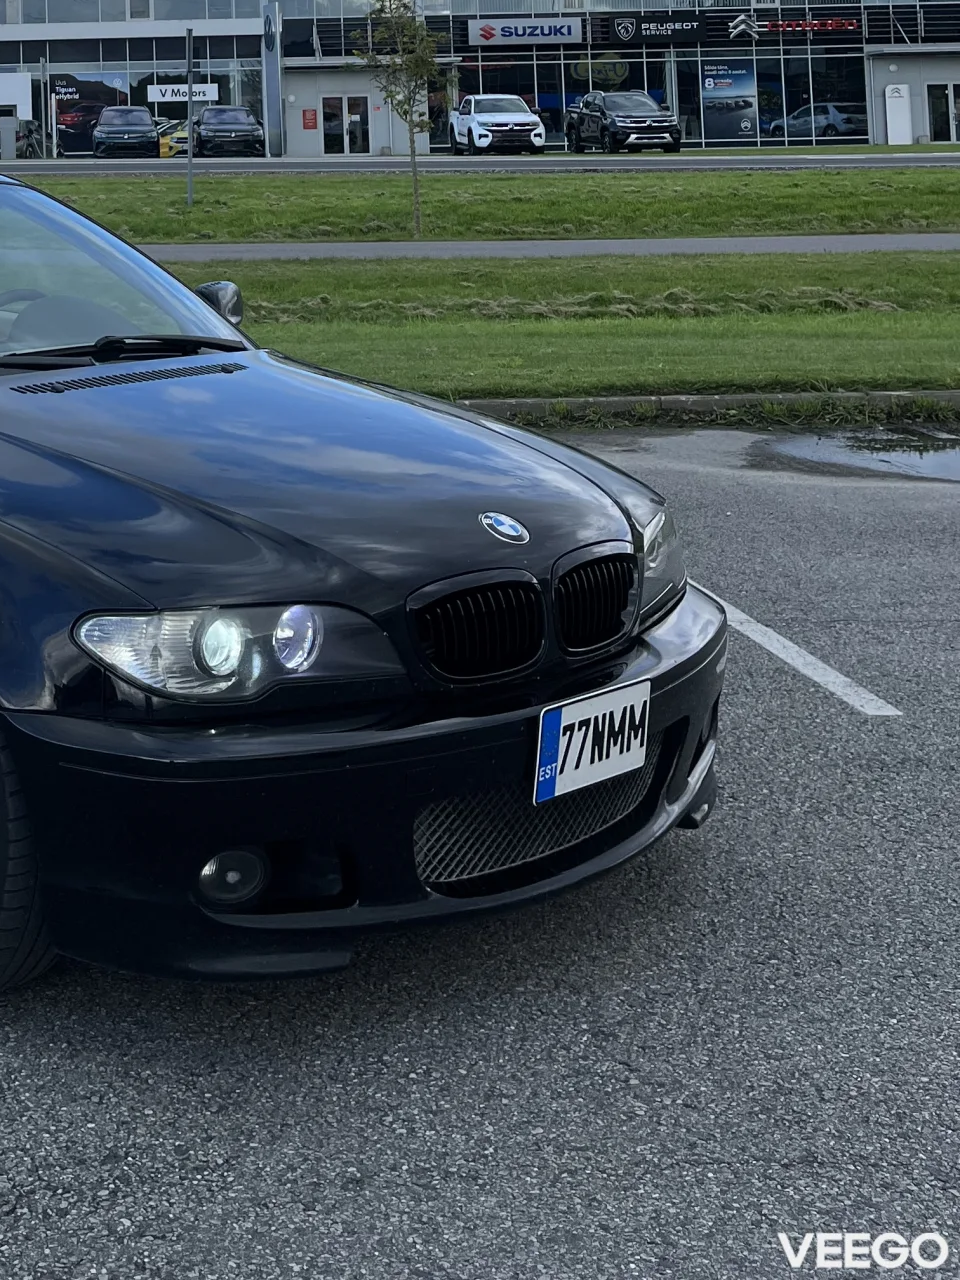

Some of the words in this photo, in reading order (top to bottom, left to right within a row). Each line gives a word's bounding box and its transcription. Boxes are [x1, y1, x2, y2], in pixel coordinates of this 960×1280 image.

[500, 25, 572, 37] SUZUKI
[641, 22, 699, 30] PEUGEOT
[705, 78, 715, 88] 8
[159, 89, 168, 97] V
[170, 88, 207, 98] Moors
[558, 700, 648, 776] 77NMM
[538, 763, 558, 781] EST
